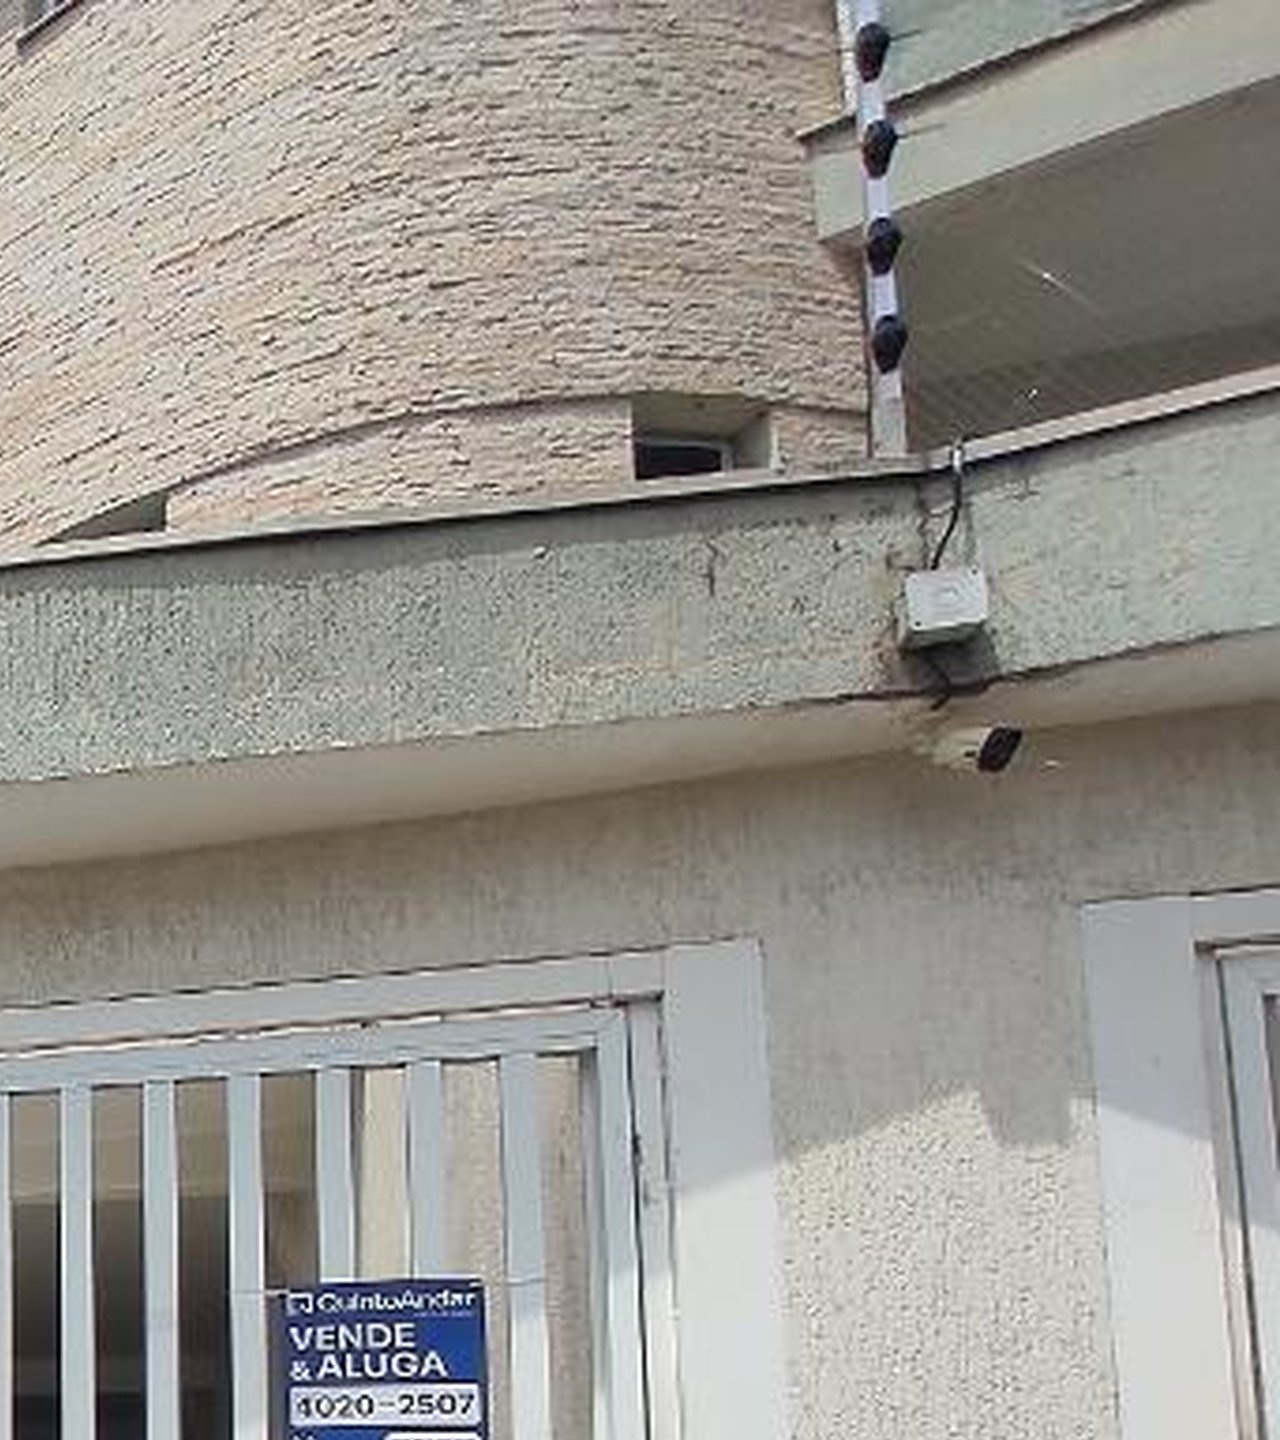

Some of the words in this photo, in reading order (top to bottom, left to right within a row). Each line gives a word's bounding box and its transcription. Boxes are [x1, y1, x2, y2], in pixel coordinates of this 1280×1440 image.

[290, 1322, 416, 1350] VENDE
[290, 1360, 312, 1381] &
[316, 1352, 448, 1378] ALUGA
[296, 1393, 474, 1416] 4020-2507
